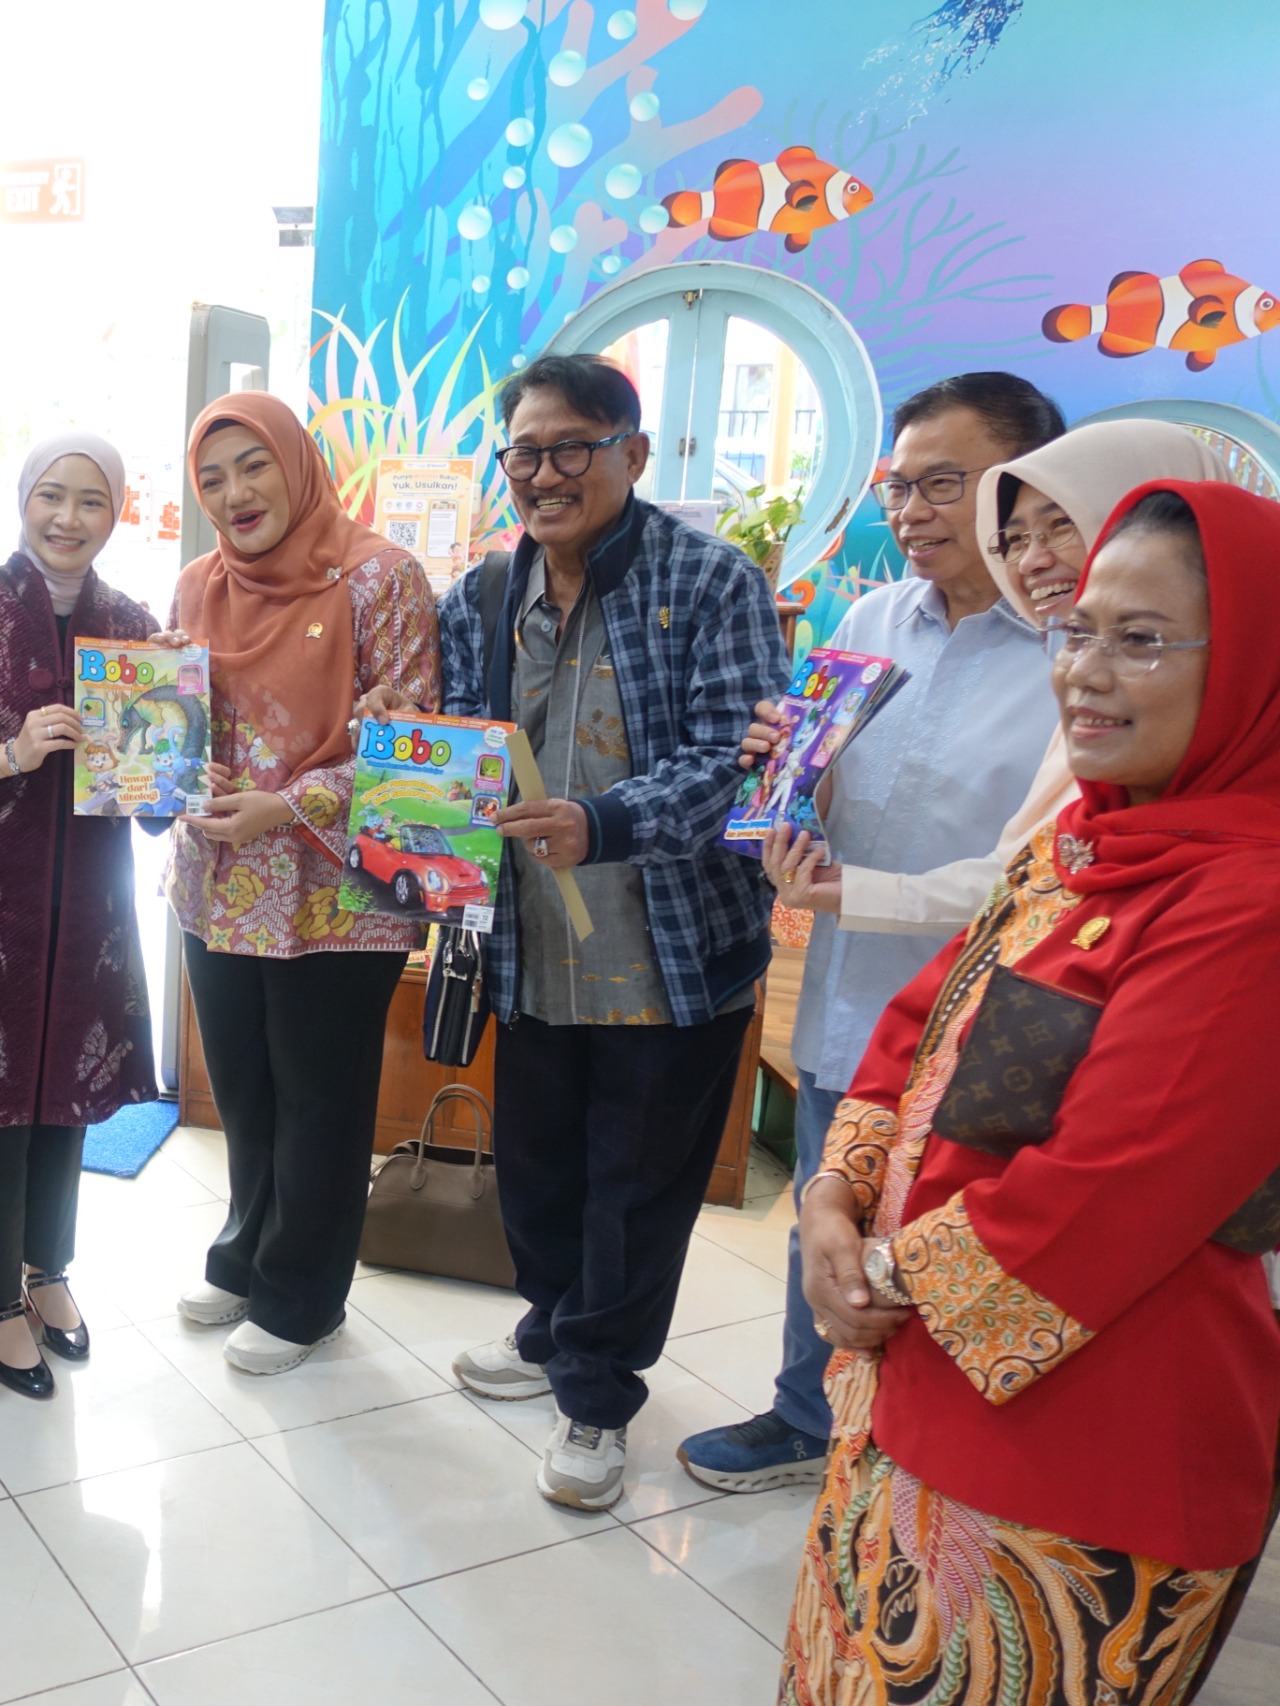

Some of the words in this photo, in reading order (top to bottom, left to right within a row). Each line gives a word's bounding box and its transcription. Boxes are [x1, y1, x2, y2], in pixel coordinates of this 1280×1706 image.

[393, 481, 413, 490] Yuk,
[415, 481, 458, 490] Usulkan!
[78, 649, 154, 684] Bobo
[784, 661, 839, 701] Bobo
[361, 721, 452, 767] Bobo
[120, 775, 153, 783] Hewan
[127, 782, 148, 792] dari
[119, 790, 158, 802] Mitologi
